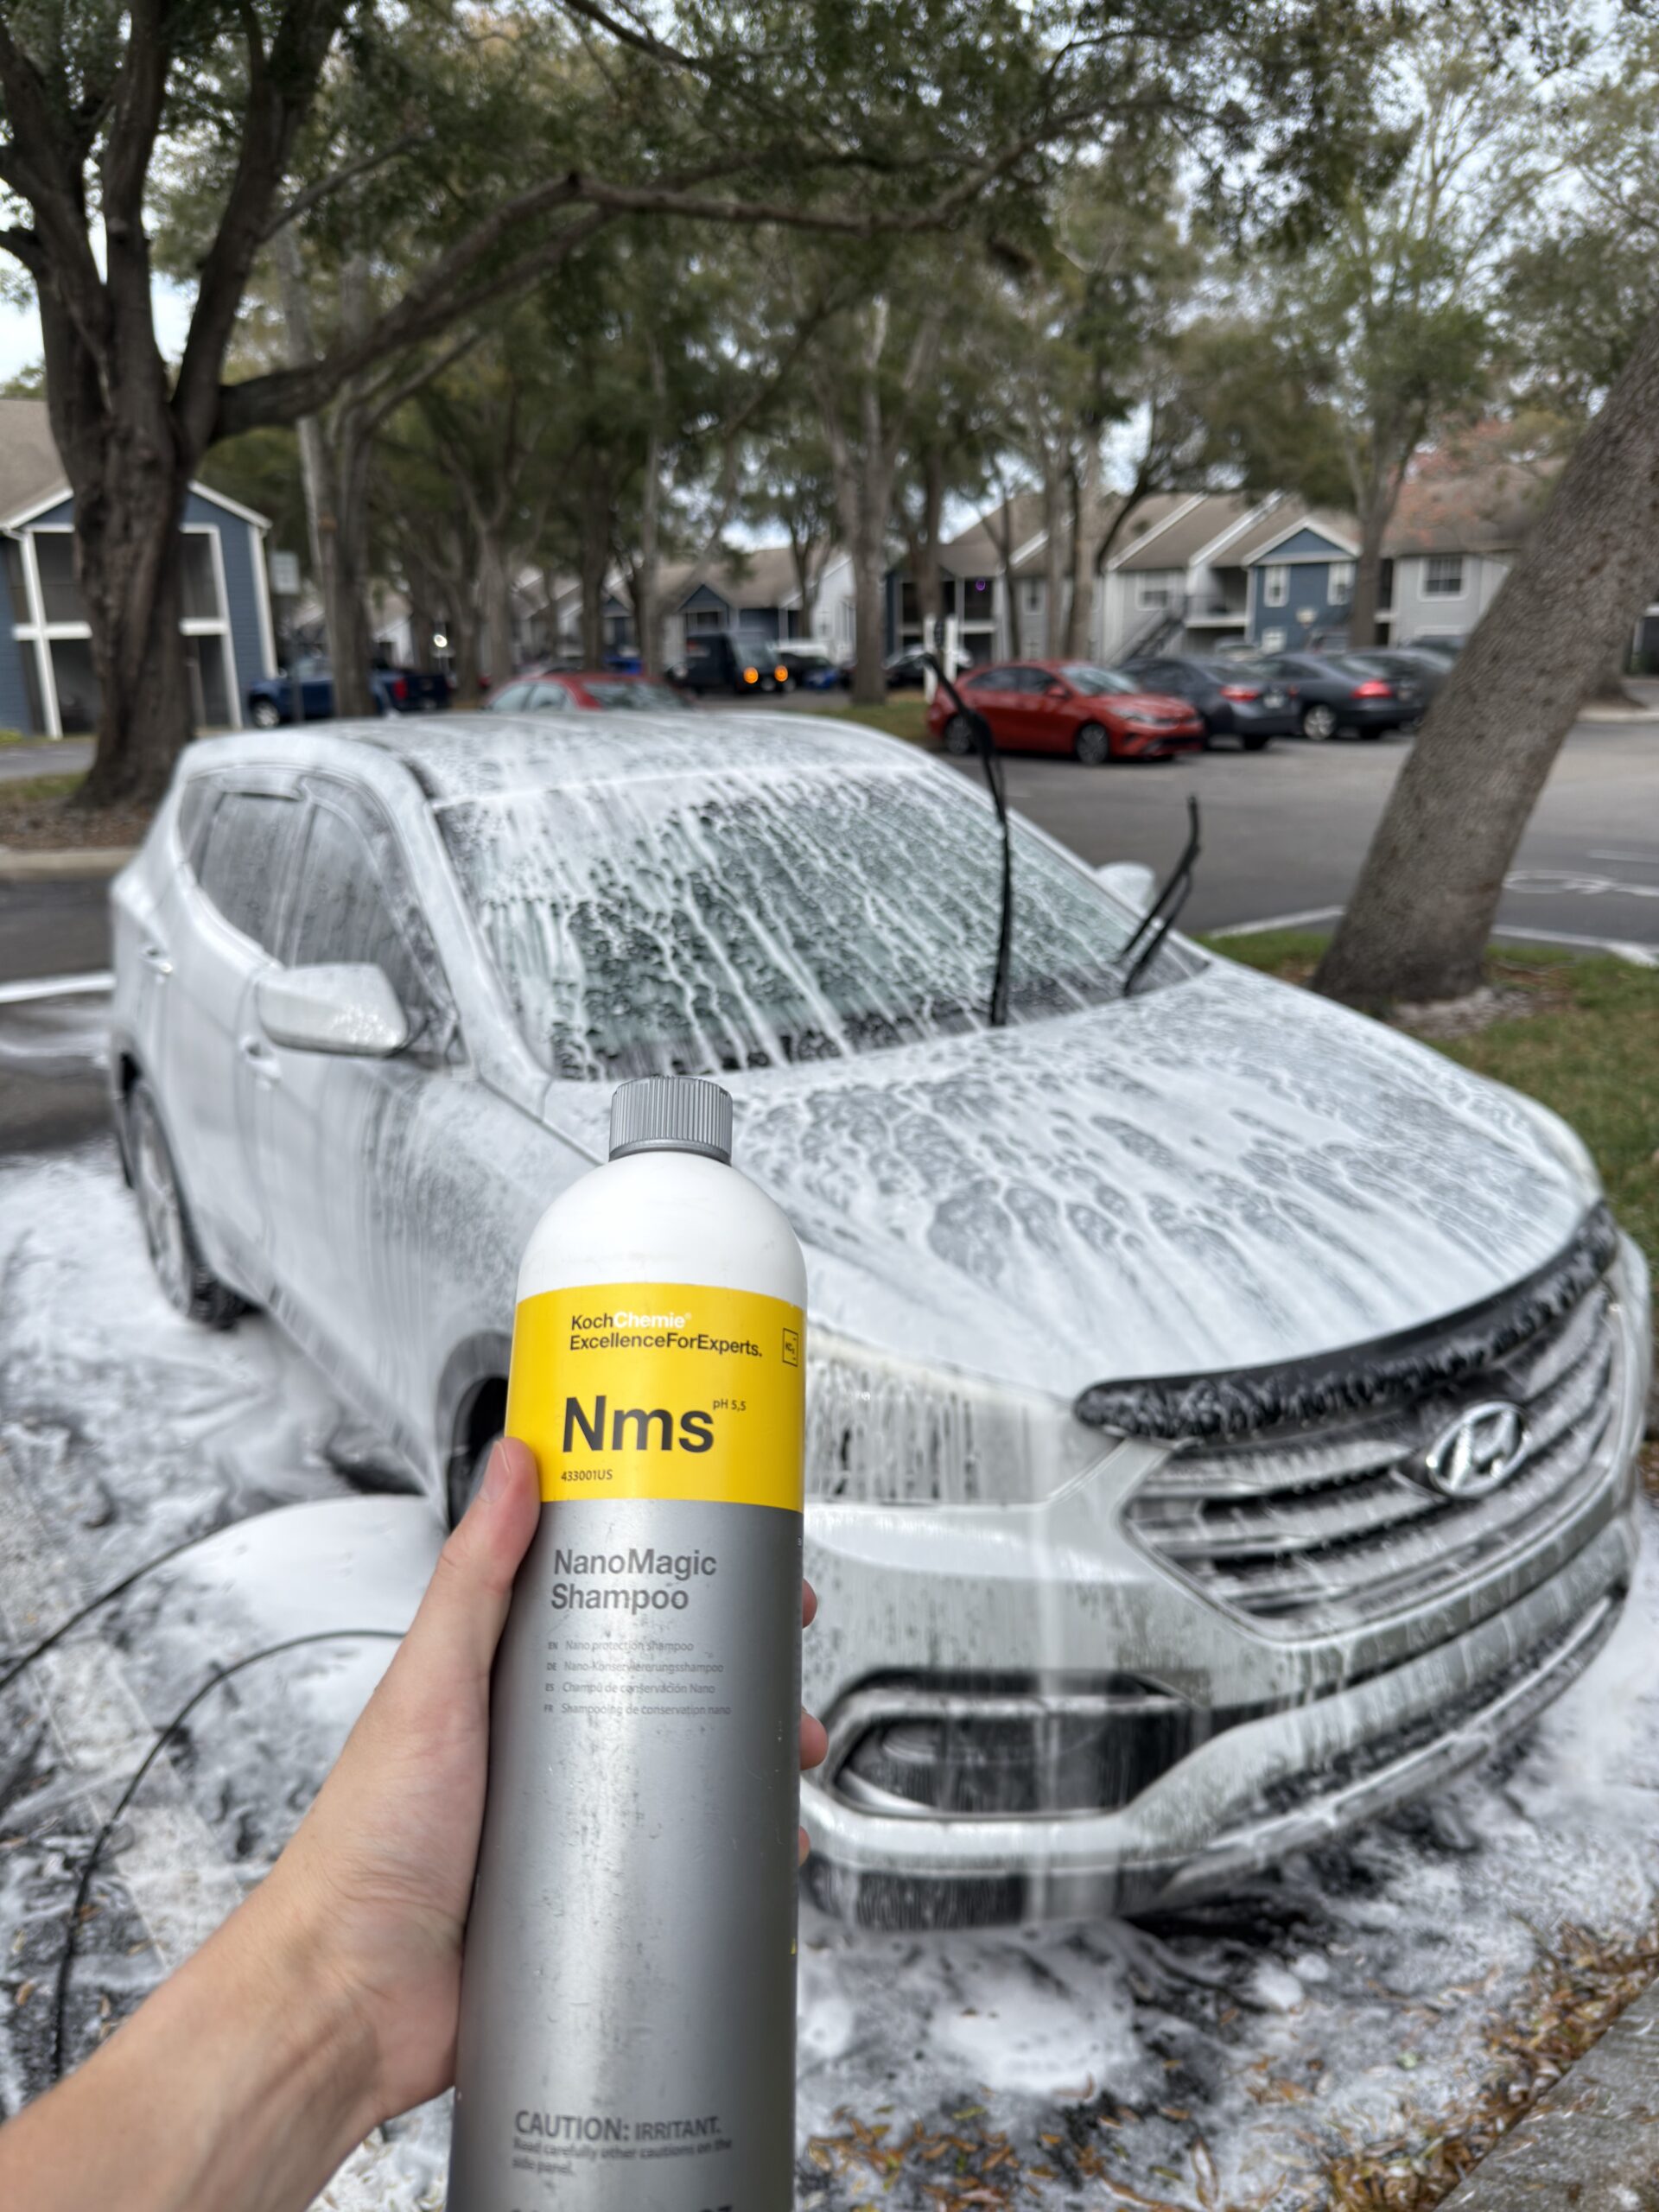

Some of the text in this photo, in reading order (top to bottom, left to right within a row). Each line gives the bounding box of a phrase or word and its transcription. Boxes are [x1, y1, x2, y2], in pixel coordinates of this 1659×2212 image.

[569, 1332, 762, 1357] ExcellenceForExperts.
[562, 1395, 747, 1453] Nms pH 5,5
[561, 1469, 613, 1482] 433001US
[554, 1548, 716, 1580] NanoMagic
[551, 1583, 689, 1615] Shampoo
[566, 1640, 590, 1651] Nano
[646, 1641, 694, 1652] shampoo
[605, 1682, 618, 1693] de
[690, 1683, 716, 1694] Nano
[626, 1704, 639, 1714] de
[515, 2110, 722, 2141] CAUTION: IRRITANT.
